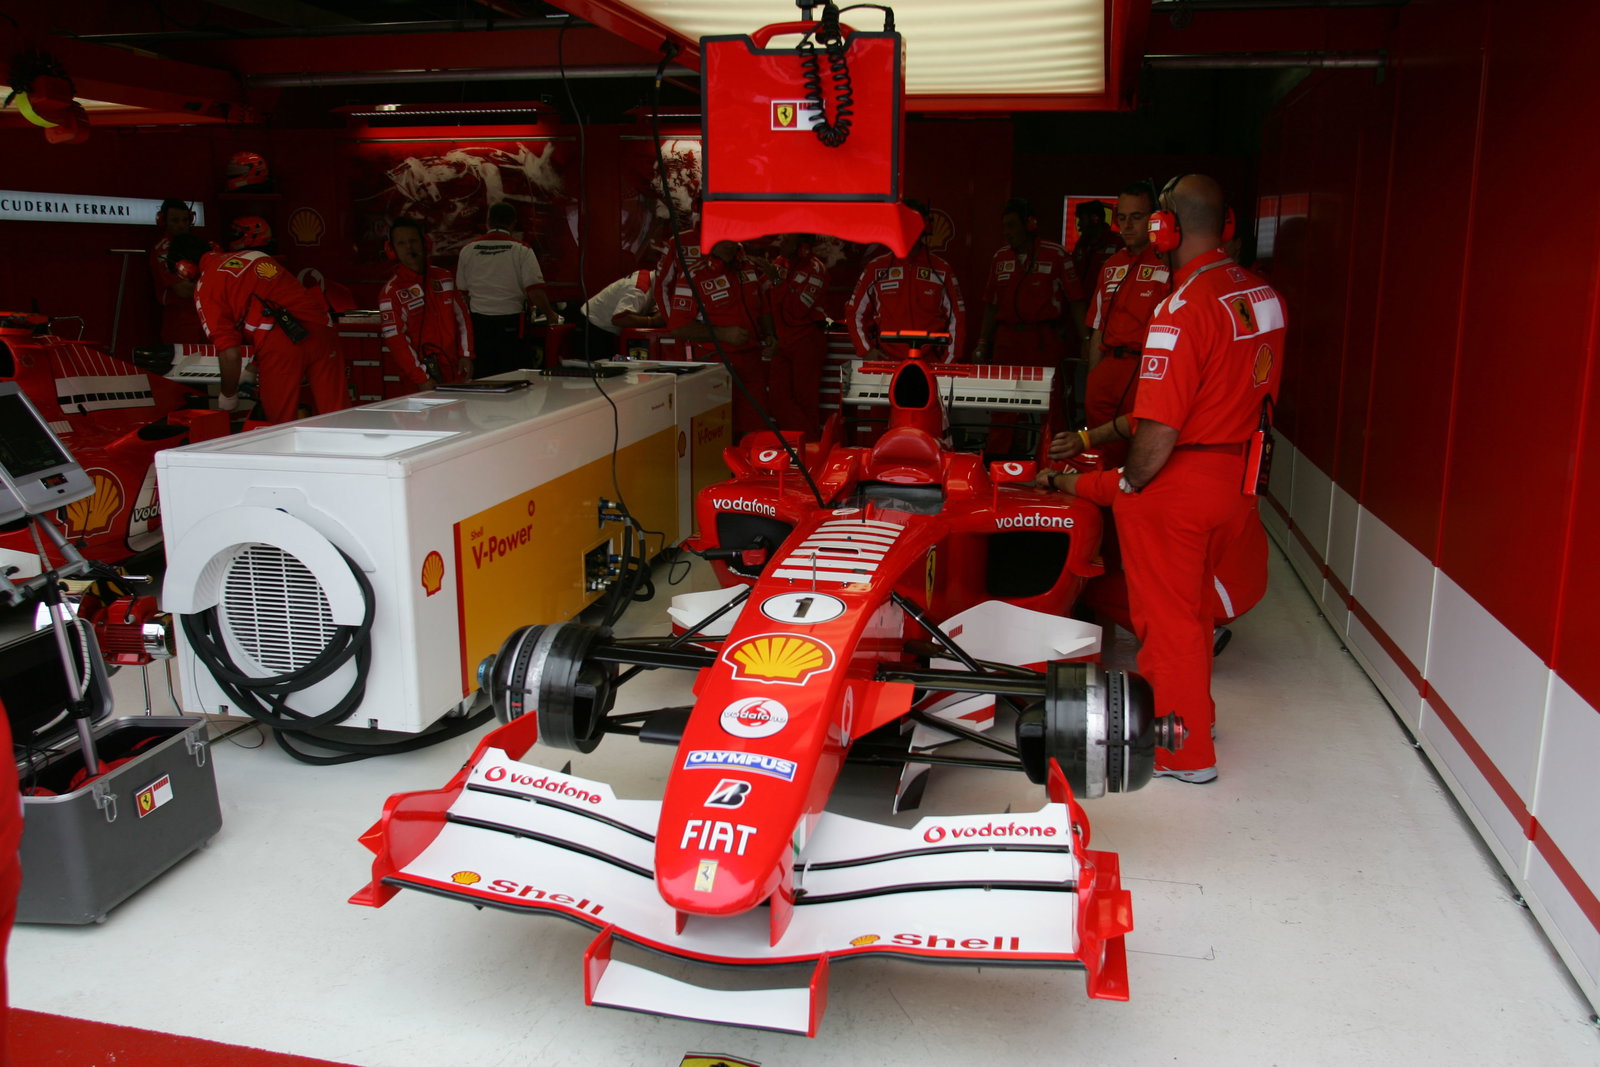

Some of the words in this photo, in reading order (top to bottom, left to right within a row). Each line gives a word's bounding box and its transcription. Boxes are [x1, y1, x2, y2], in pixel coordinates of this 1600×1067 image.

[1, 199, 69, 213] CUDERIA
[76, 203, 130, 216] FERRARI
[712, 497, 776, 517] vodafone
[995, 512, 1075, 529] vodafone
[472, 524, 533, 569] V-Power
[793, 597, 814, 618] 1
[723, 709, 787, 723] vodafone
[690, 751, 793, 774] OLYMPUS
[510, 771, 602, 804] vodafone
[680, 820, 757, 856] FIAT
[951, 822, 1057, 838] vodafone
[487, 879, 604, 916] Shell
[891, 933, 1019, 951] Shell
